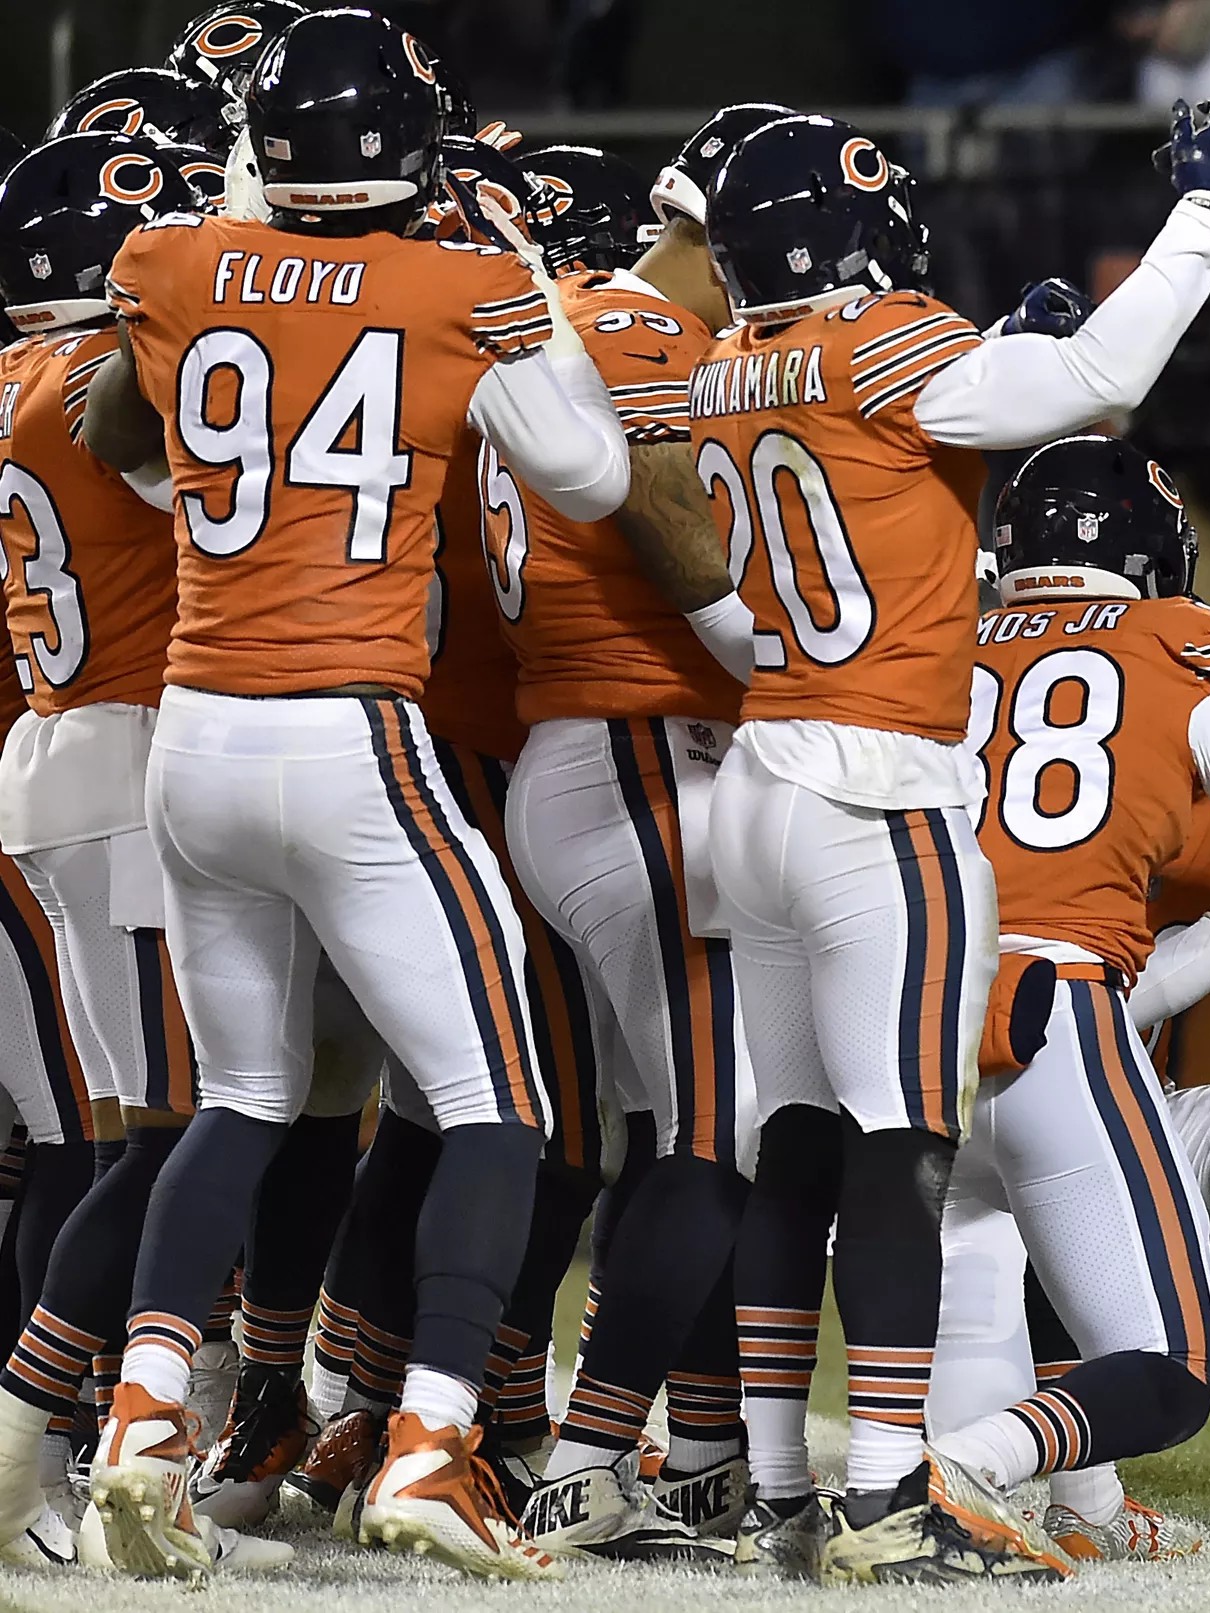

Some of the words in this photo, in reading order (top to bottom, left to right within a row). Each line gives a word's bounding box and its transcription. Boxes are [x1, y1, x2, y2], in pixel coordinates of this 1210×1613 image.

[212, 250, 367, 305] FLOYD
[688, 345, 827, 420] MUKAMARA
[176, 326, 414, 564] 94
[0, 458, 91, 694] 3
[1014, 576, 1085, 592] BEARS
[1063, 603, 1129, 636] JR
[656, 1469, 731, 1528] NIKE
